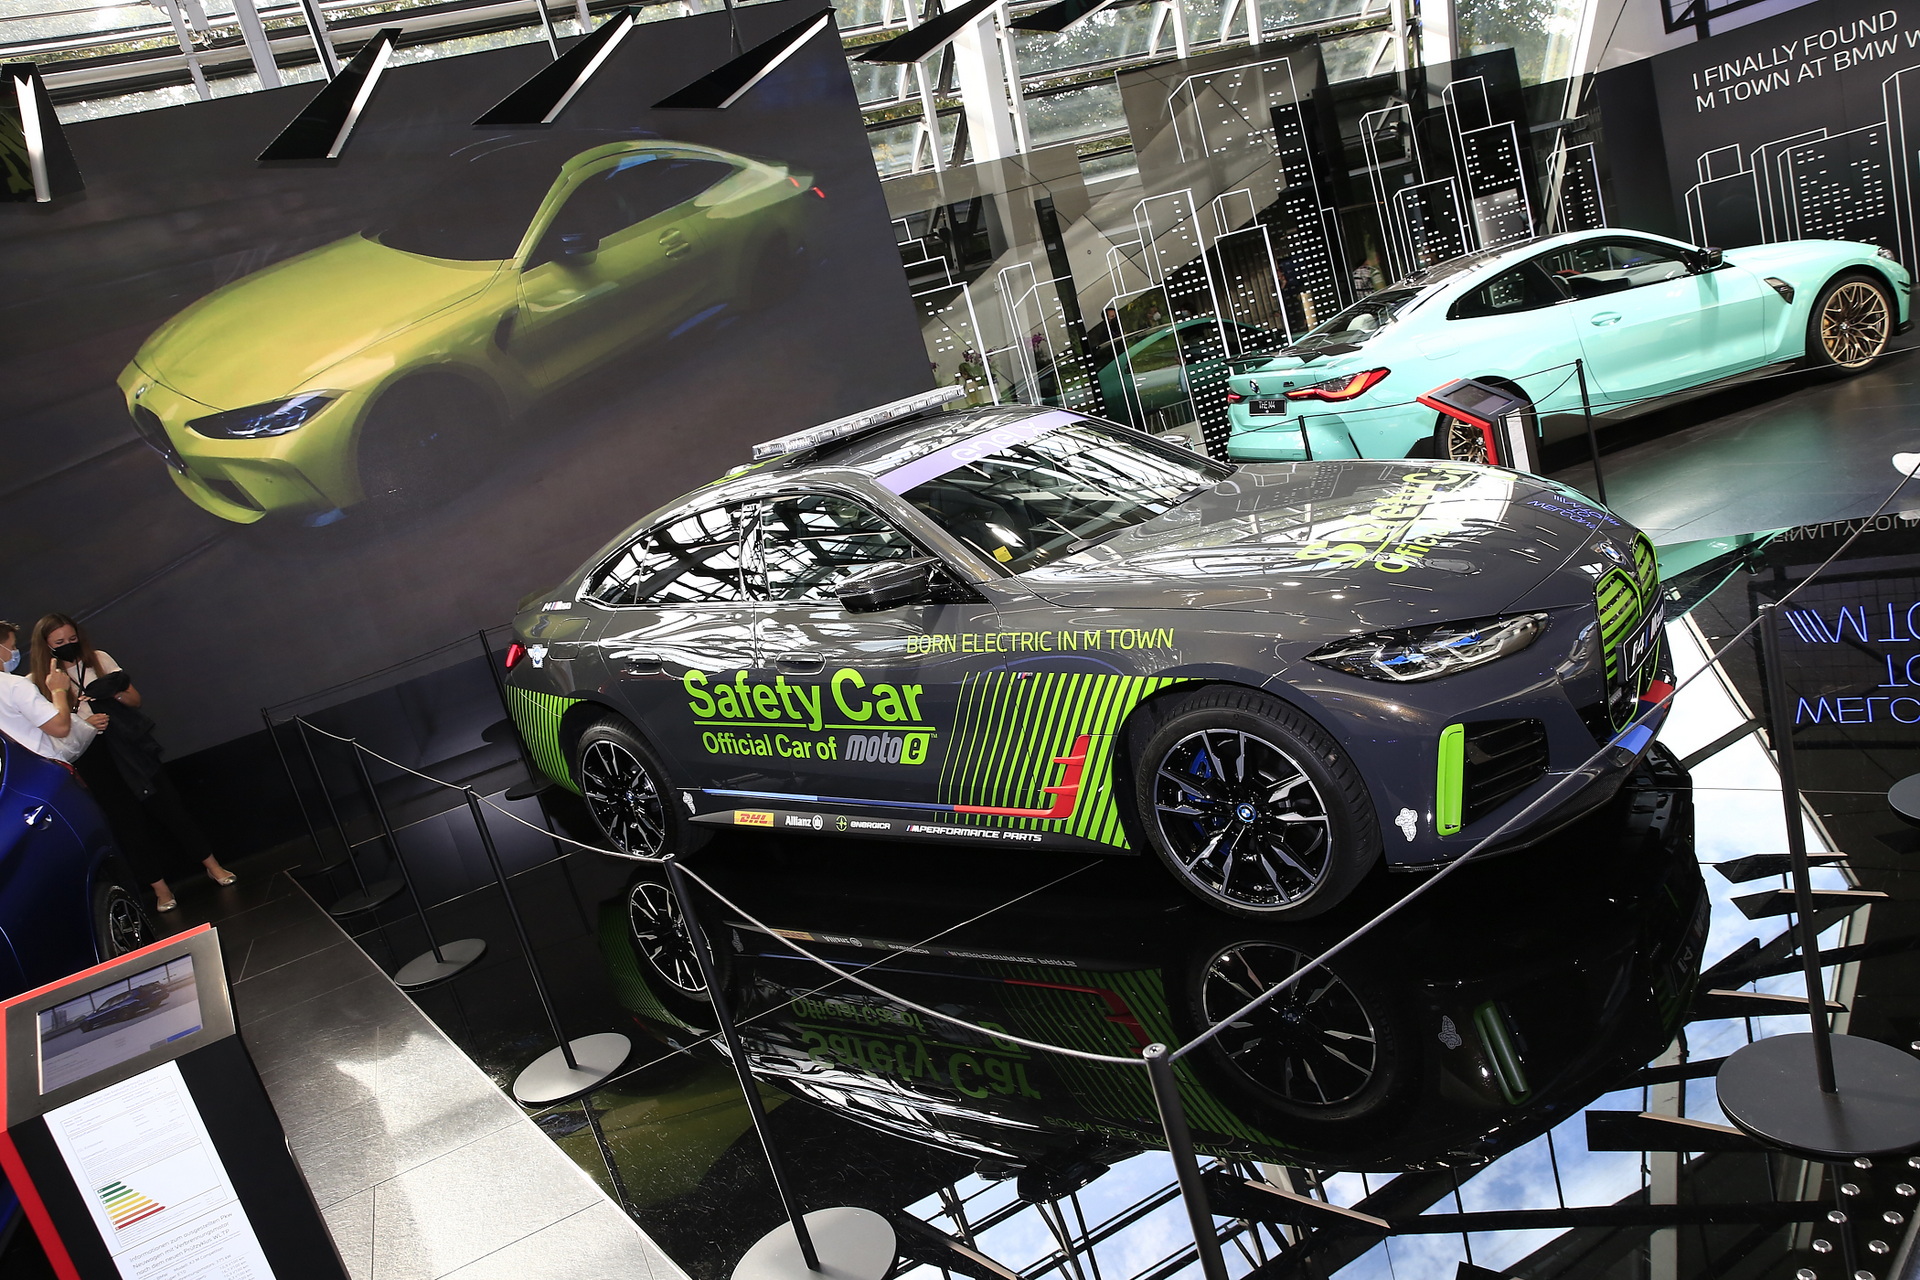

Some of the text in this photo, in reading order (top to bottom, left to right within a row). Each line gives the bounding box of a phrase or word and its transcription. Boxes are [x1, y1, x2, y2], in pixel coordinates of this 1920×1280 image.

[1692, 9, 1898, 90] I FINALLY FOUND
[1696, 91, 1716, 113] M
[1718, 68, 1790, 104] TOWN
[1797, 56, 1827, 83] AT
[1833, 34, 1898, 72] BMW
[906, 627, 1175, 655] BORN ELECTRIC IN M TOWN
[683, 667, 923, 731] Safety Car
[702, 731, 773, 757] Official
[775, 733, 812, 759] Car
[815, 736, 837, 760] of
[739, 812, 768, 825] DHL
[785, 815, 812, 828] Allianz
[919, 825, 1000, 839] PERFORMANCE
[1003, 831, 1042, 842] PARTS
[129, 1240, 170, 1263] Informationen
